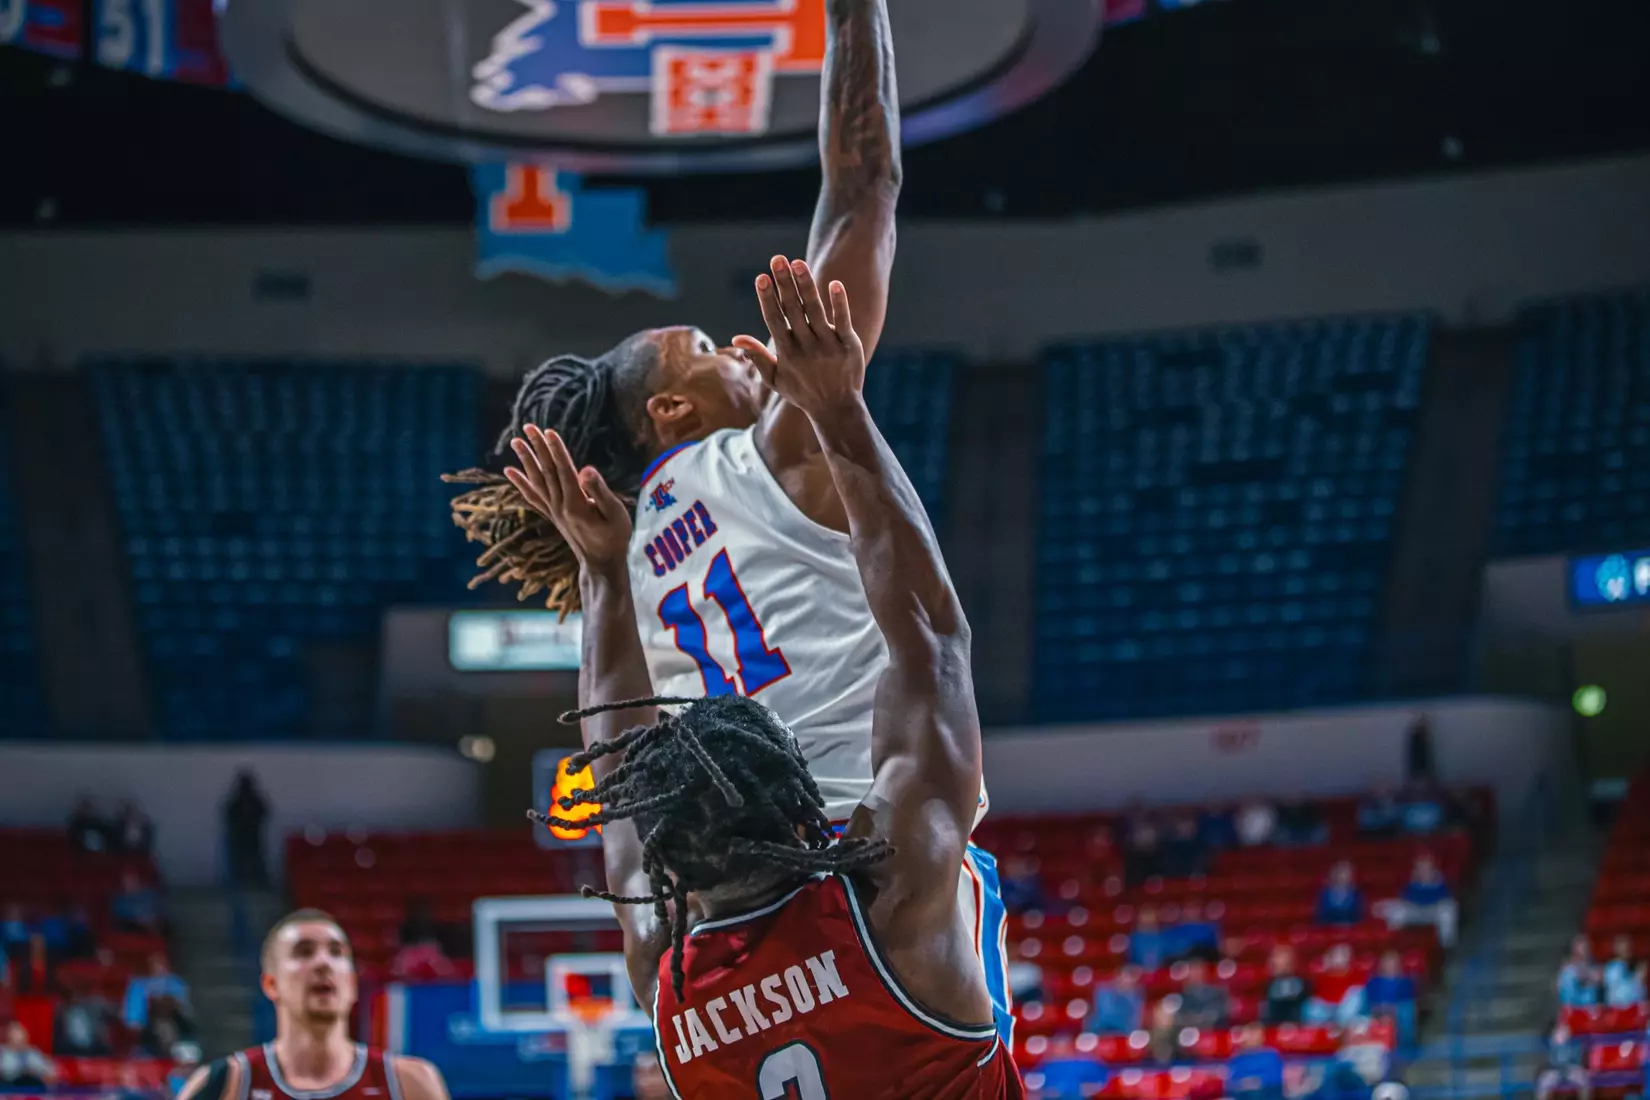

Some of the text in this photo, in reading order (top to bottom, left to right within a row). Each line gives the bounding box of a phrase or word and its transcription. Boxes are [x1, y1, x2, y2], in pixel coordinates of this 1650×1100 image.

[644, 499, 718, 578] COOPER
[657, 546, 792, 698] 11
[671, 949, 849, 1065] JACKSON
